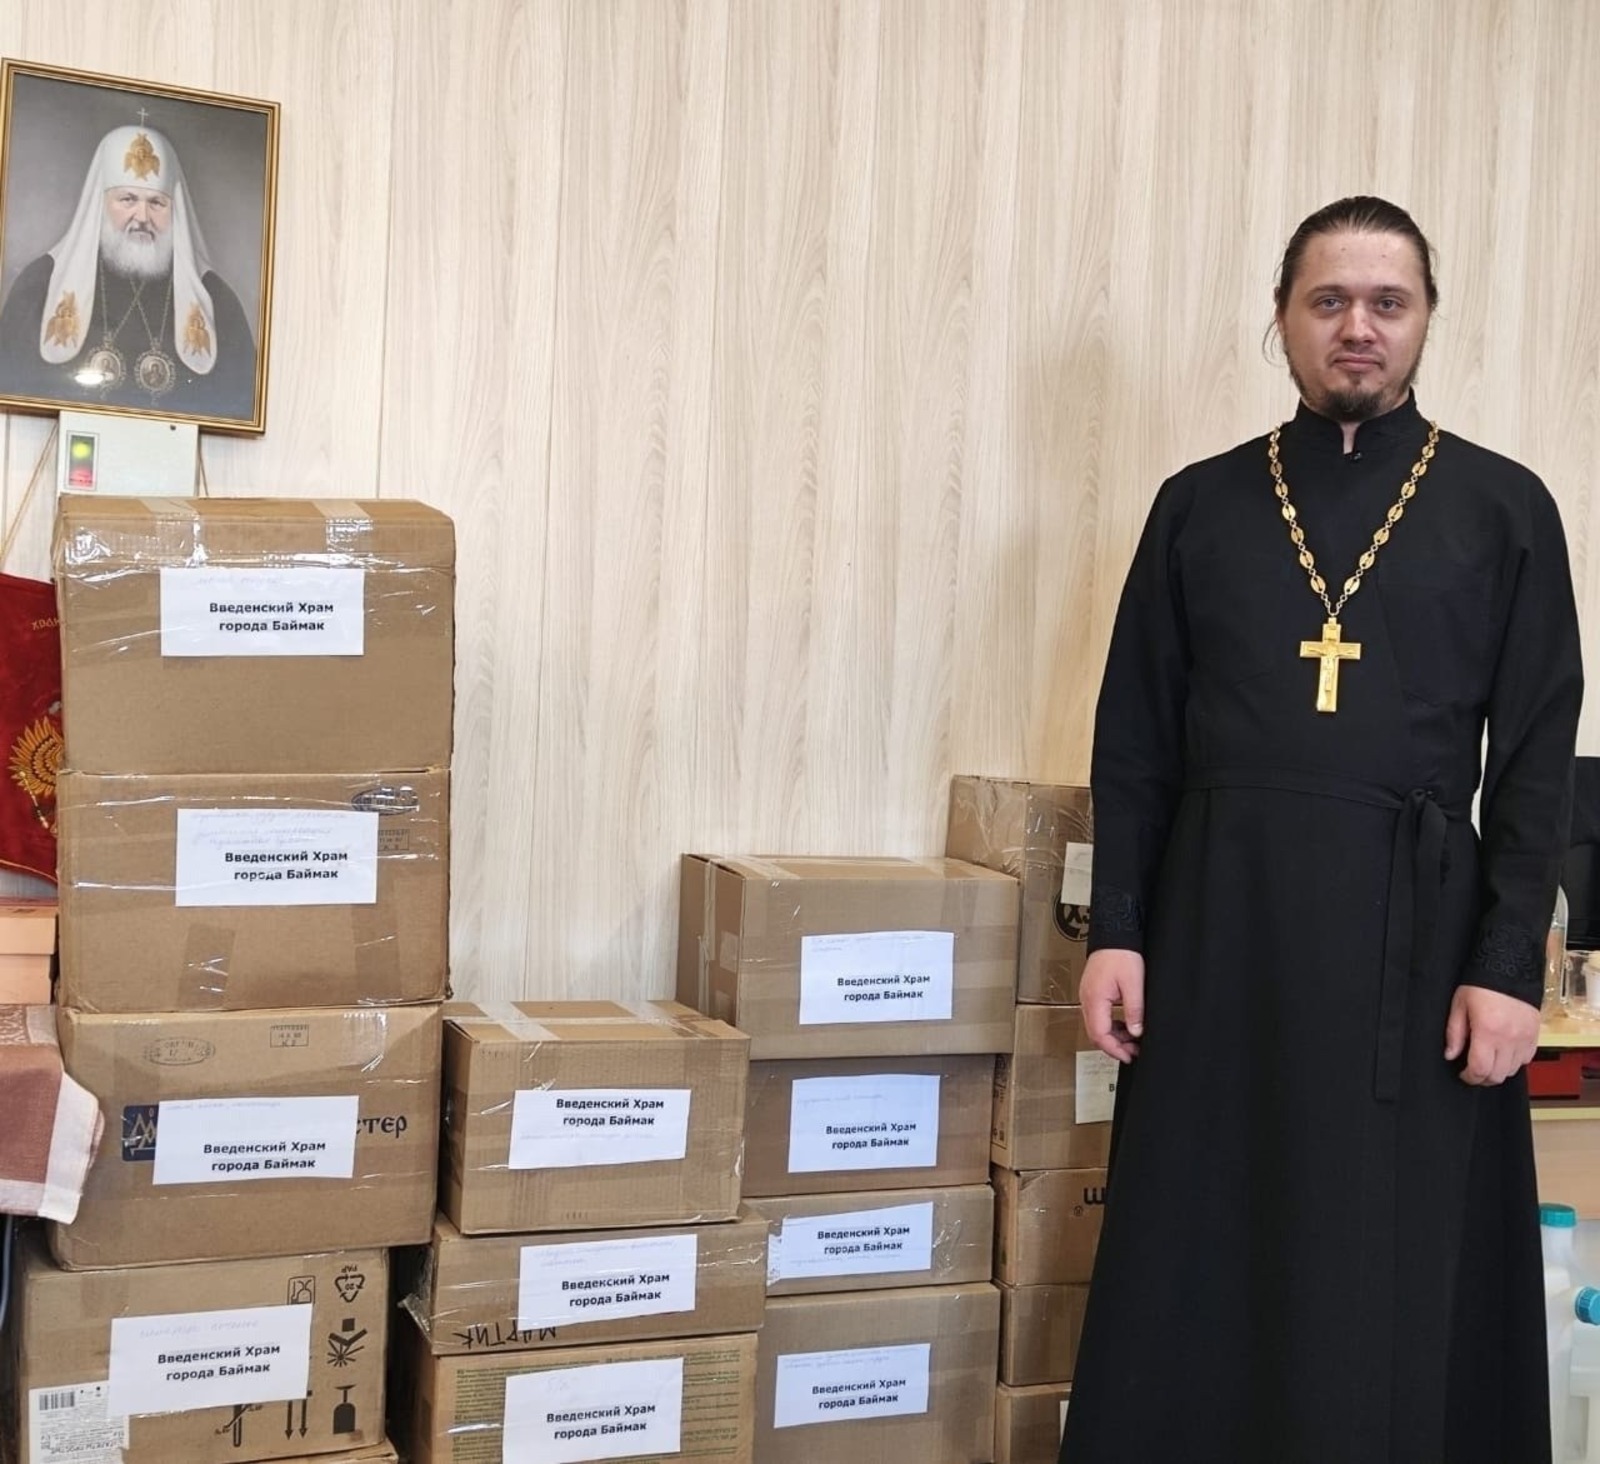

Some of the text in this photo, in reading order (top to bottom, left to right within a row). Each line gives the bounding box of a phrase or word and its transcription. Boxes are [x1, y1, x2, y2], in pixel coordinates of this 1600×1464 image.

[209, 601, 334, 614] Введенский Храм
[219, 619, 325, 633] города Баймак
[224, 850, 348, 863] Введенский Храм
[286, 868, 339, 879] Баймак
[837, 974, 931, 986] Введенский Храм
[843, 989, 924, 1002] города Баймак
[555, 1098, 665, 1110] Введенский Храм
[562, 1115, 655, 1127] города Баймак
[825, 1122, 917, 1134] Введенский Храм
[203, 1141, 326, 1155] Введенский Храм
[831, 1137, 910, 1150] города Баймак
[211, 1158, 316, 1172] города Баймак
[817, 1226, 910, 1239] Введенский Храм
[824, 1241, 903, 1255] города Баймак
[638, 1273, 670, 1285] Храм
[569, 1290, 662, 1308] города Баймак
[157, 1345, 281, 1365] Введенский Храм
[166, 1363, 271, 1381] города Баймак
[812, 1379, 906, 1395] Введенский Храм
[818, 1394, 899, 1409] города Баймак
[546, 1404, 656, 1423] Введенский Храм
[553, 1422, 647, 1440] города Баймак
